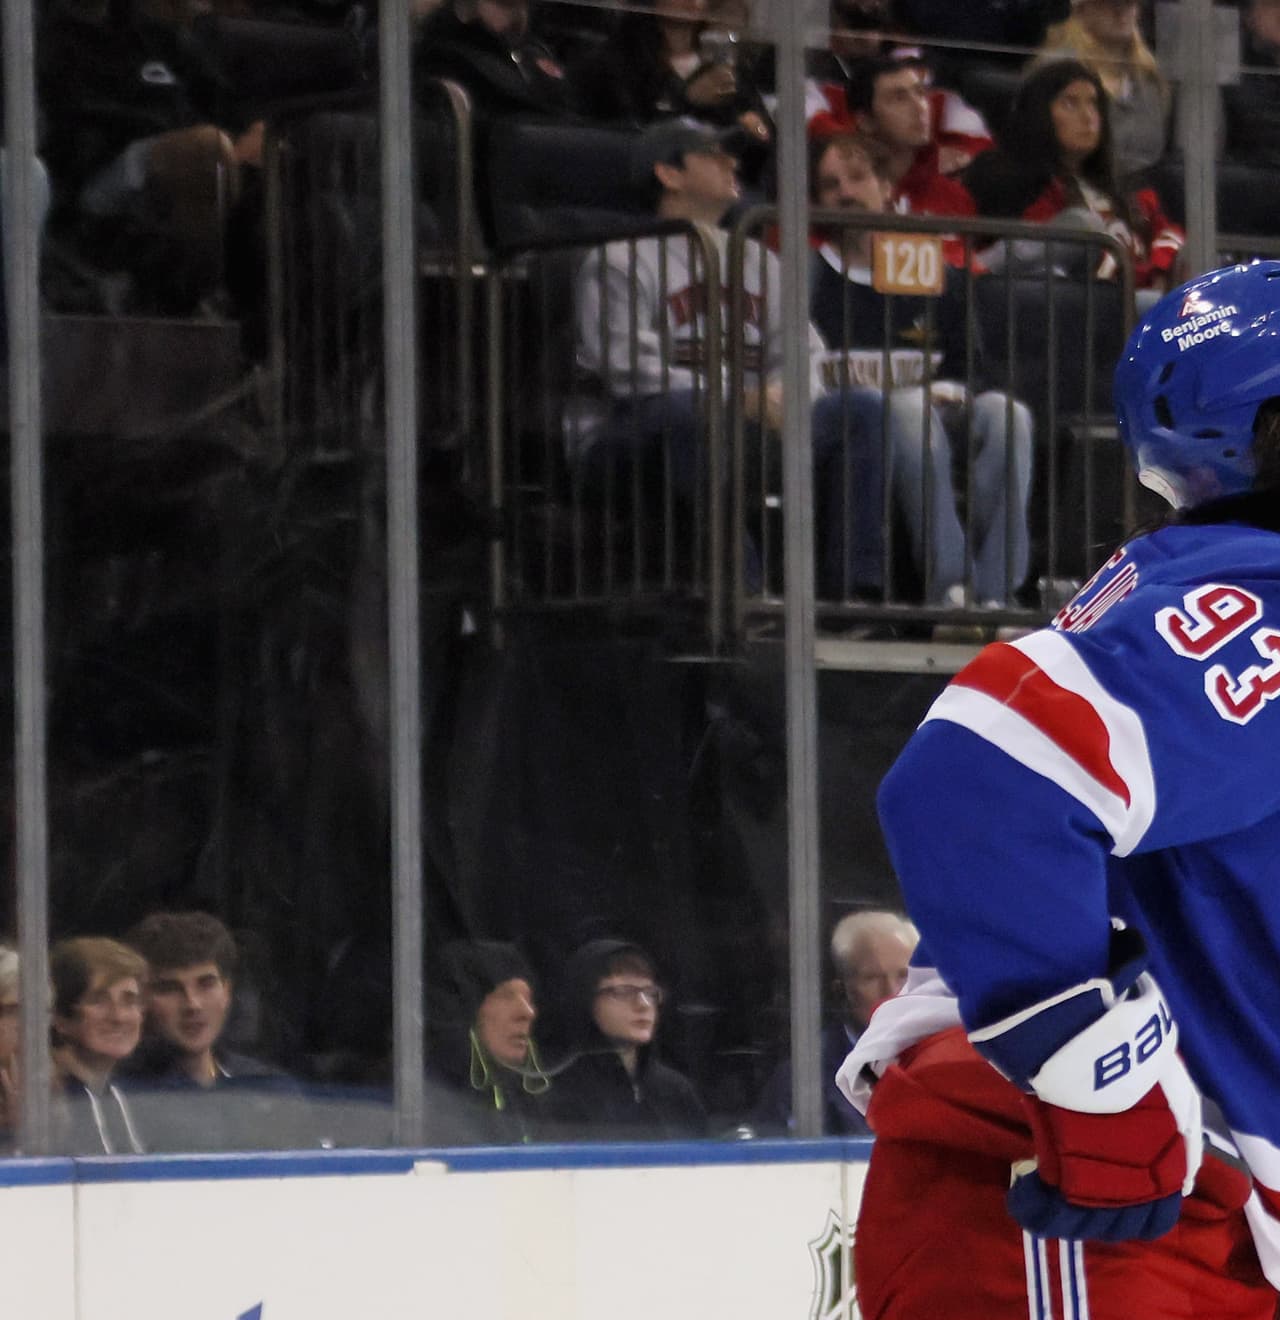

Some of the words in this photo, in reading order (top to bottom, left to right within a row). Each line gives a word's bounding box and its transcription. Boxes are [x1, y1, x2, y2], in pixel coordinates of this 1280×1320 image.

[882, 240, 938, 287] 120
[1161, 304, 1237, 343] Benjamin
[1177, 320, 1232, 352] Moore
